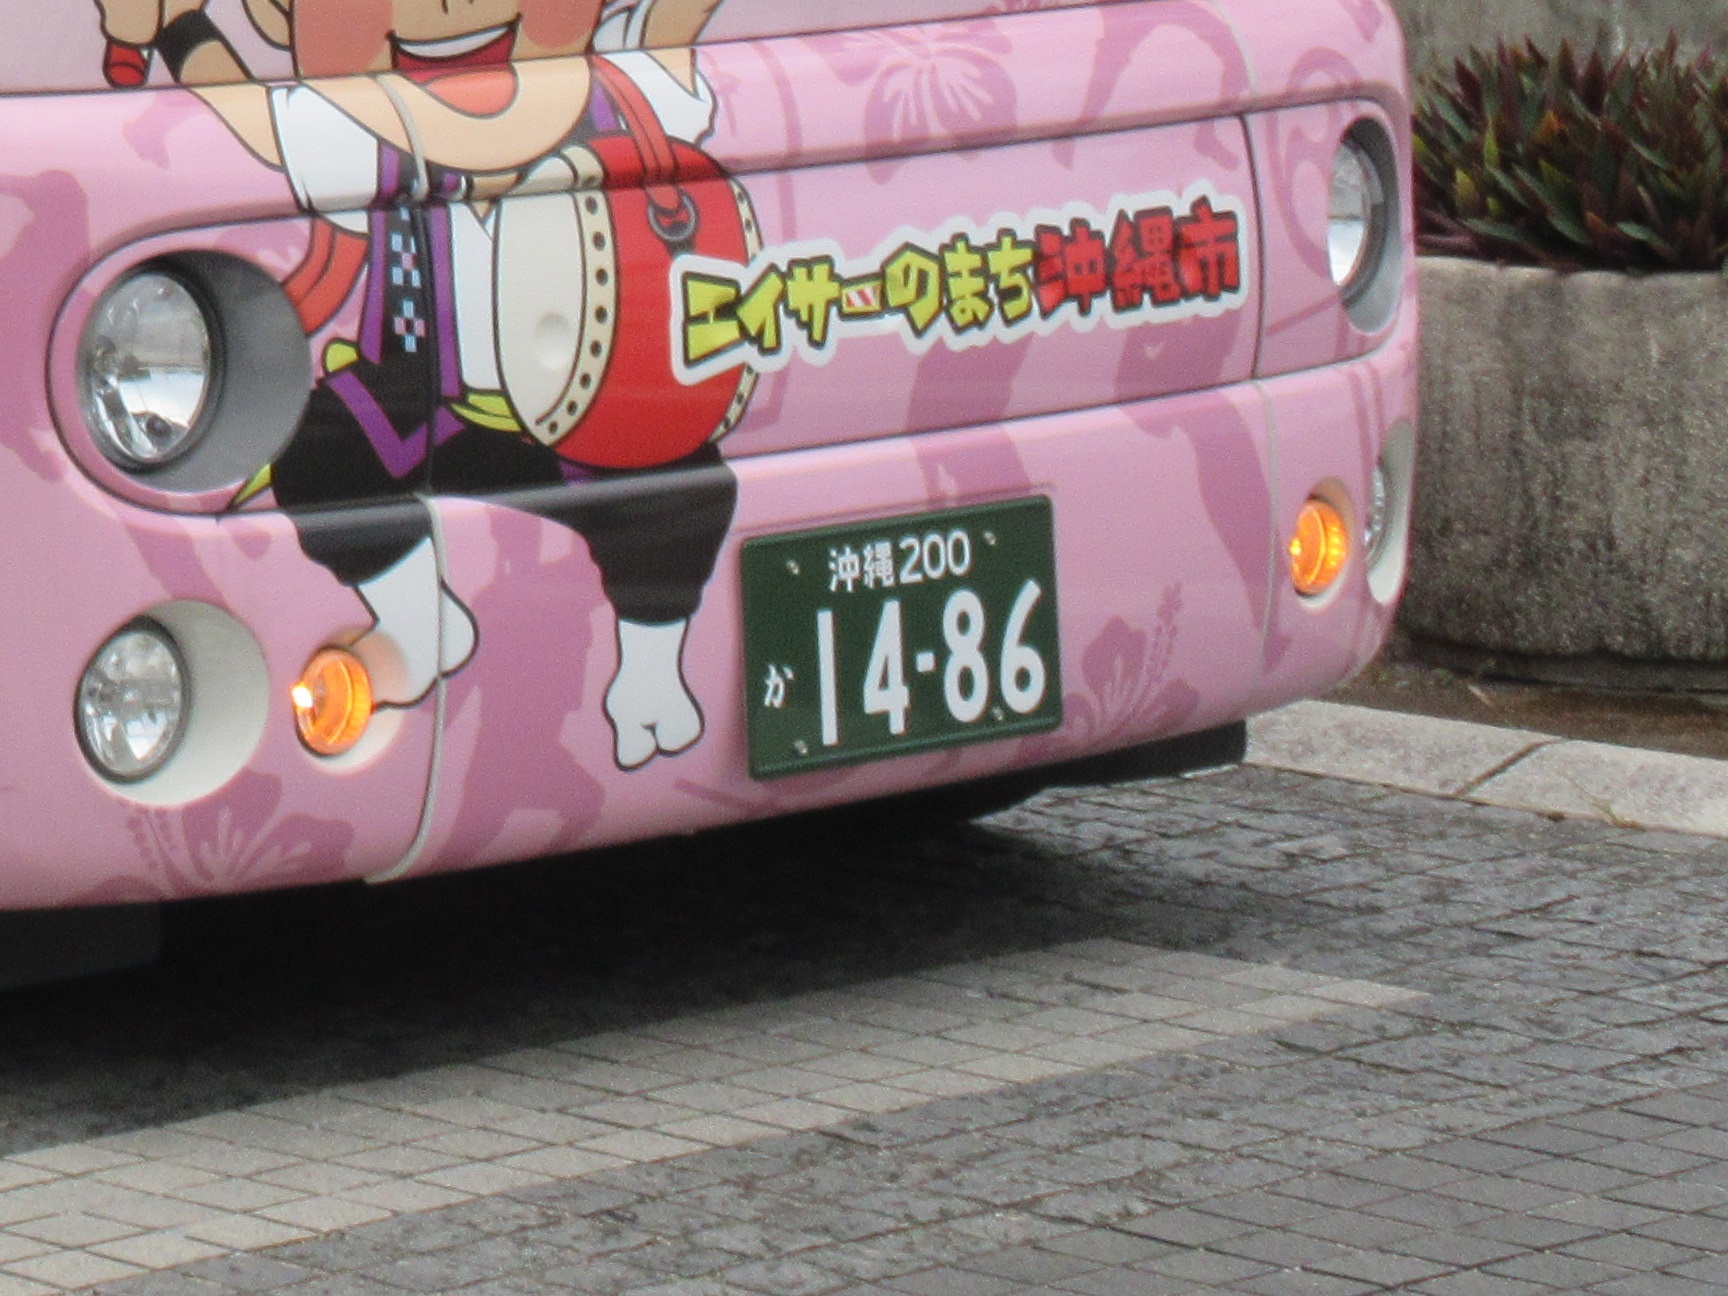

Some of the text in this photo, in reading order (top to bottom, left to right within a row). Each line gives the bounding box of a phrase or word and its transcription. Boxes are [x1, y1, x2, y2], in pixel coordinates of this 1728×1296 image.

[680, 195, 1241, 368] エイサーのまち沖縄市
[763, 578, 1047, 747] か 14-86
